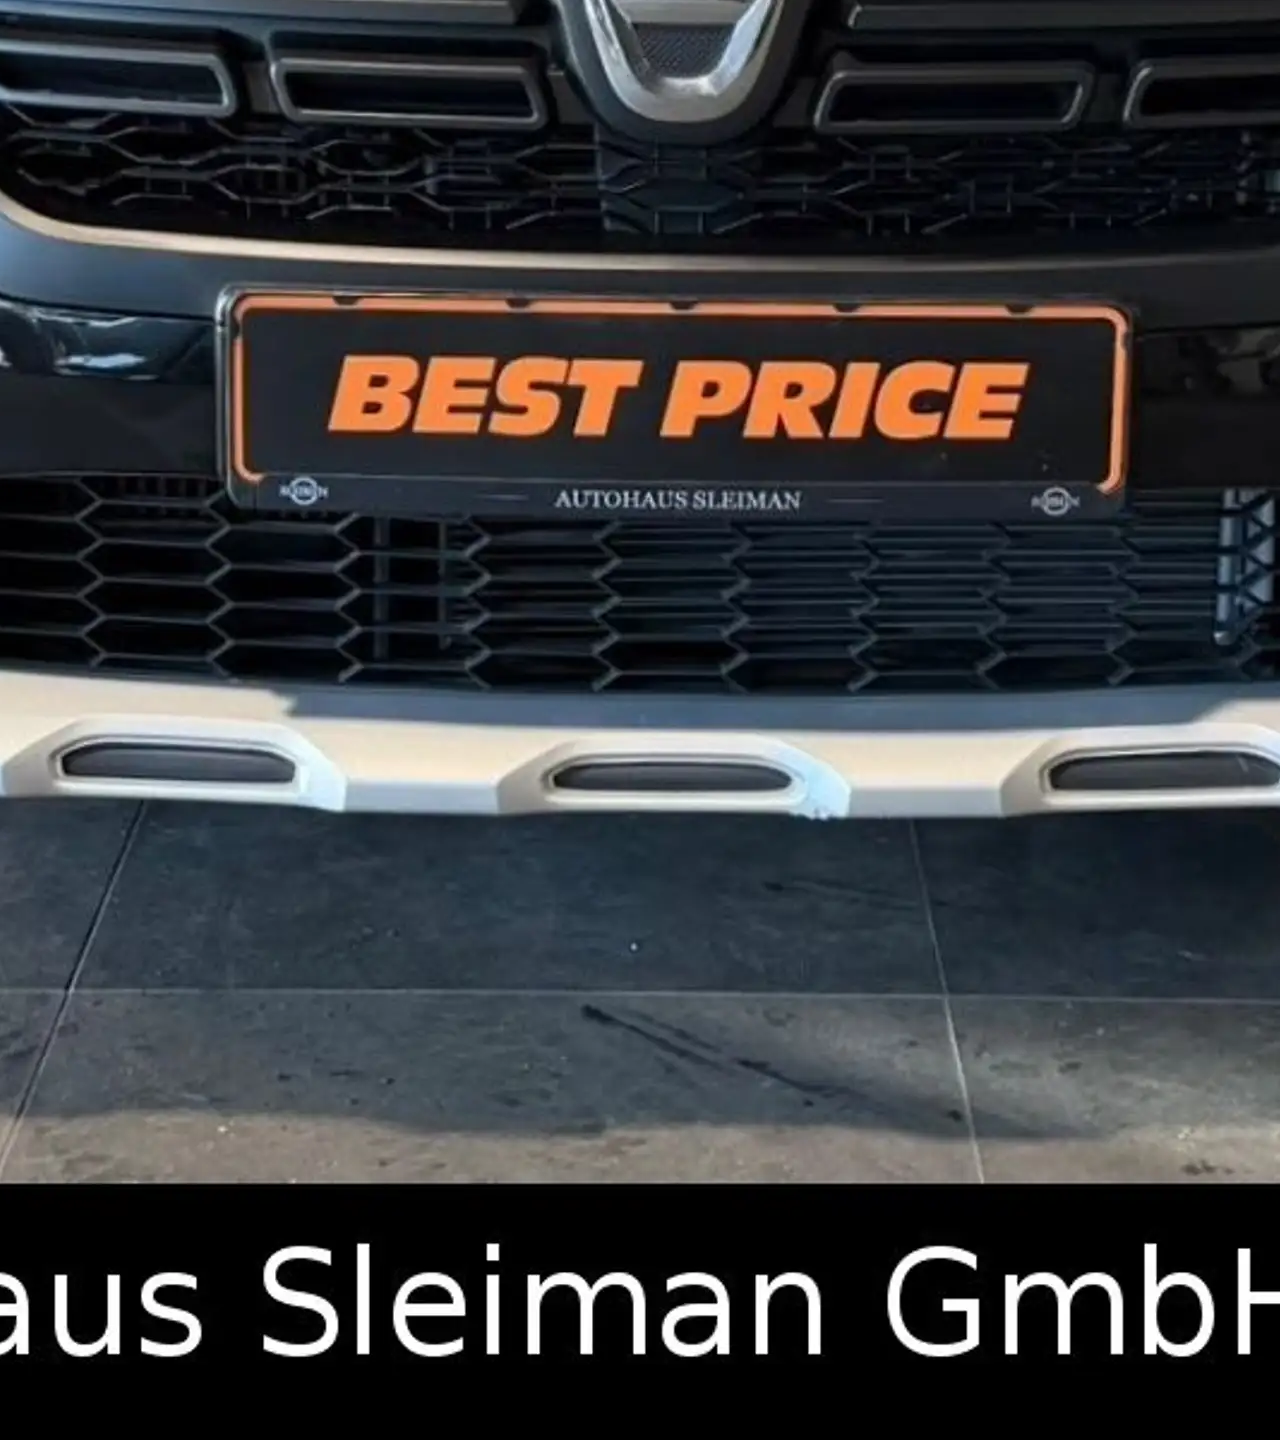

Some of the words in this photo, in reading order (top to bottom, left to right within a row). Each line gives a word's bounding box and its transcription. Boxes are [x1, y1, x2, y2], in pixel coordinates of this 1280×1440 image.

[328, 355, 642, 435] BEST
[660, 361, 1029, 439] PRICE
[554, 489, 687, 509] AUTOHAUS
[692, 490, 802, 511] SLEIMAN
